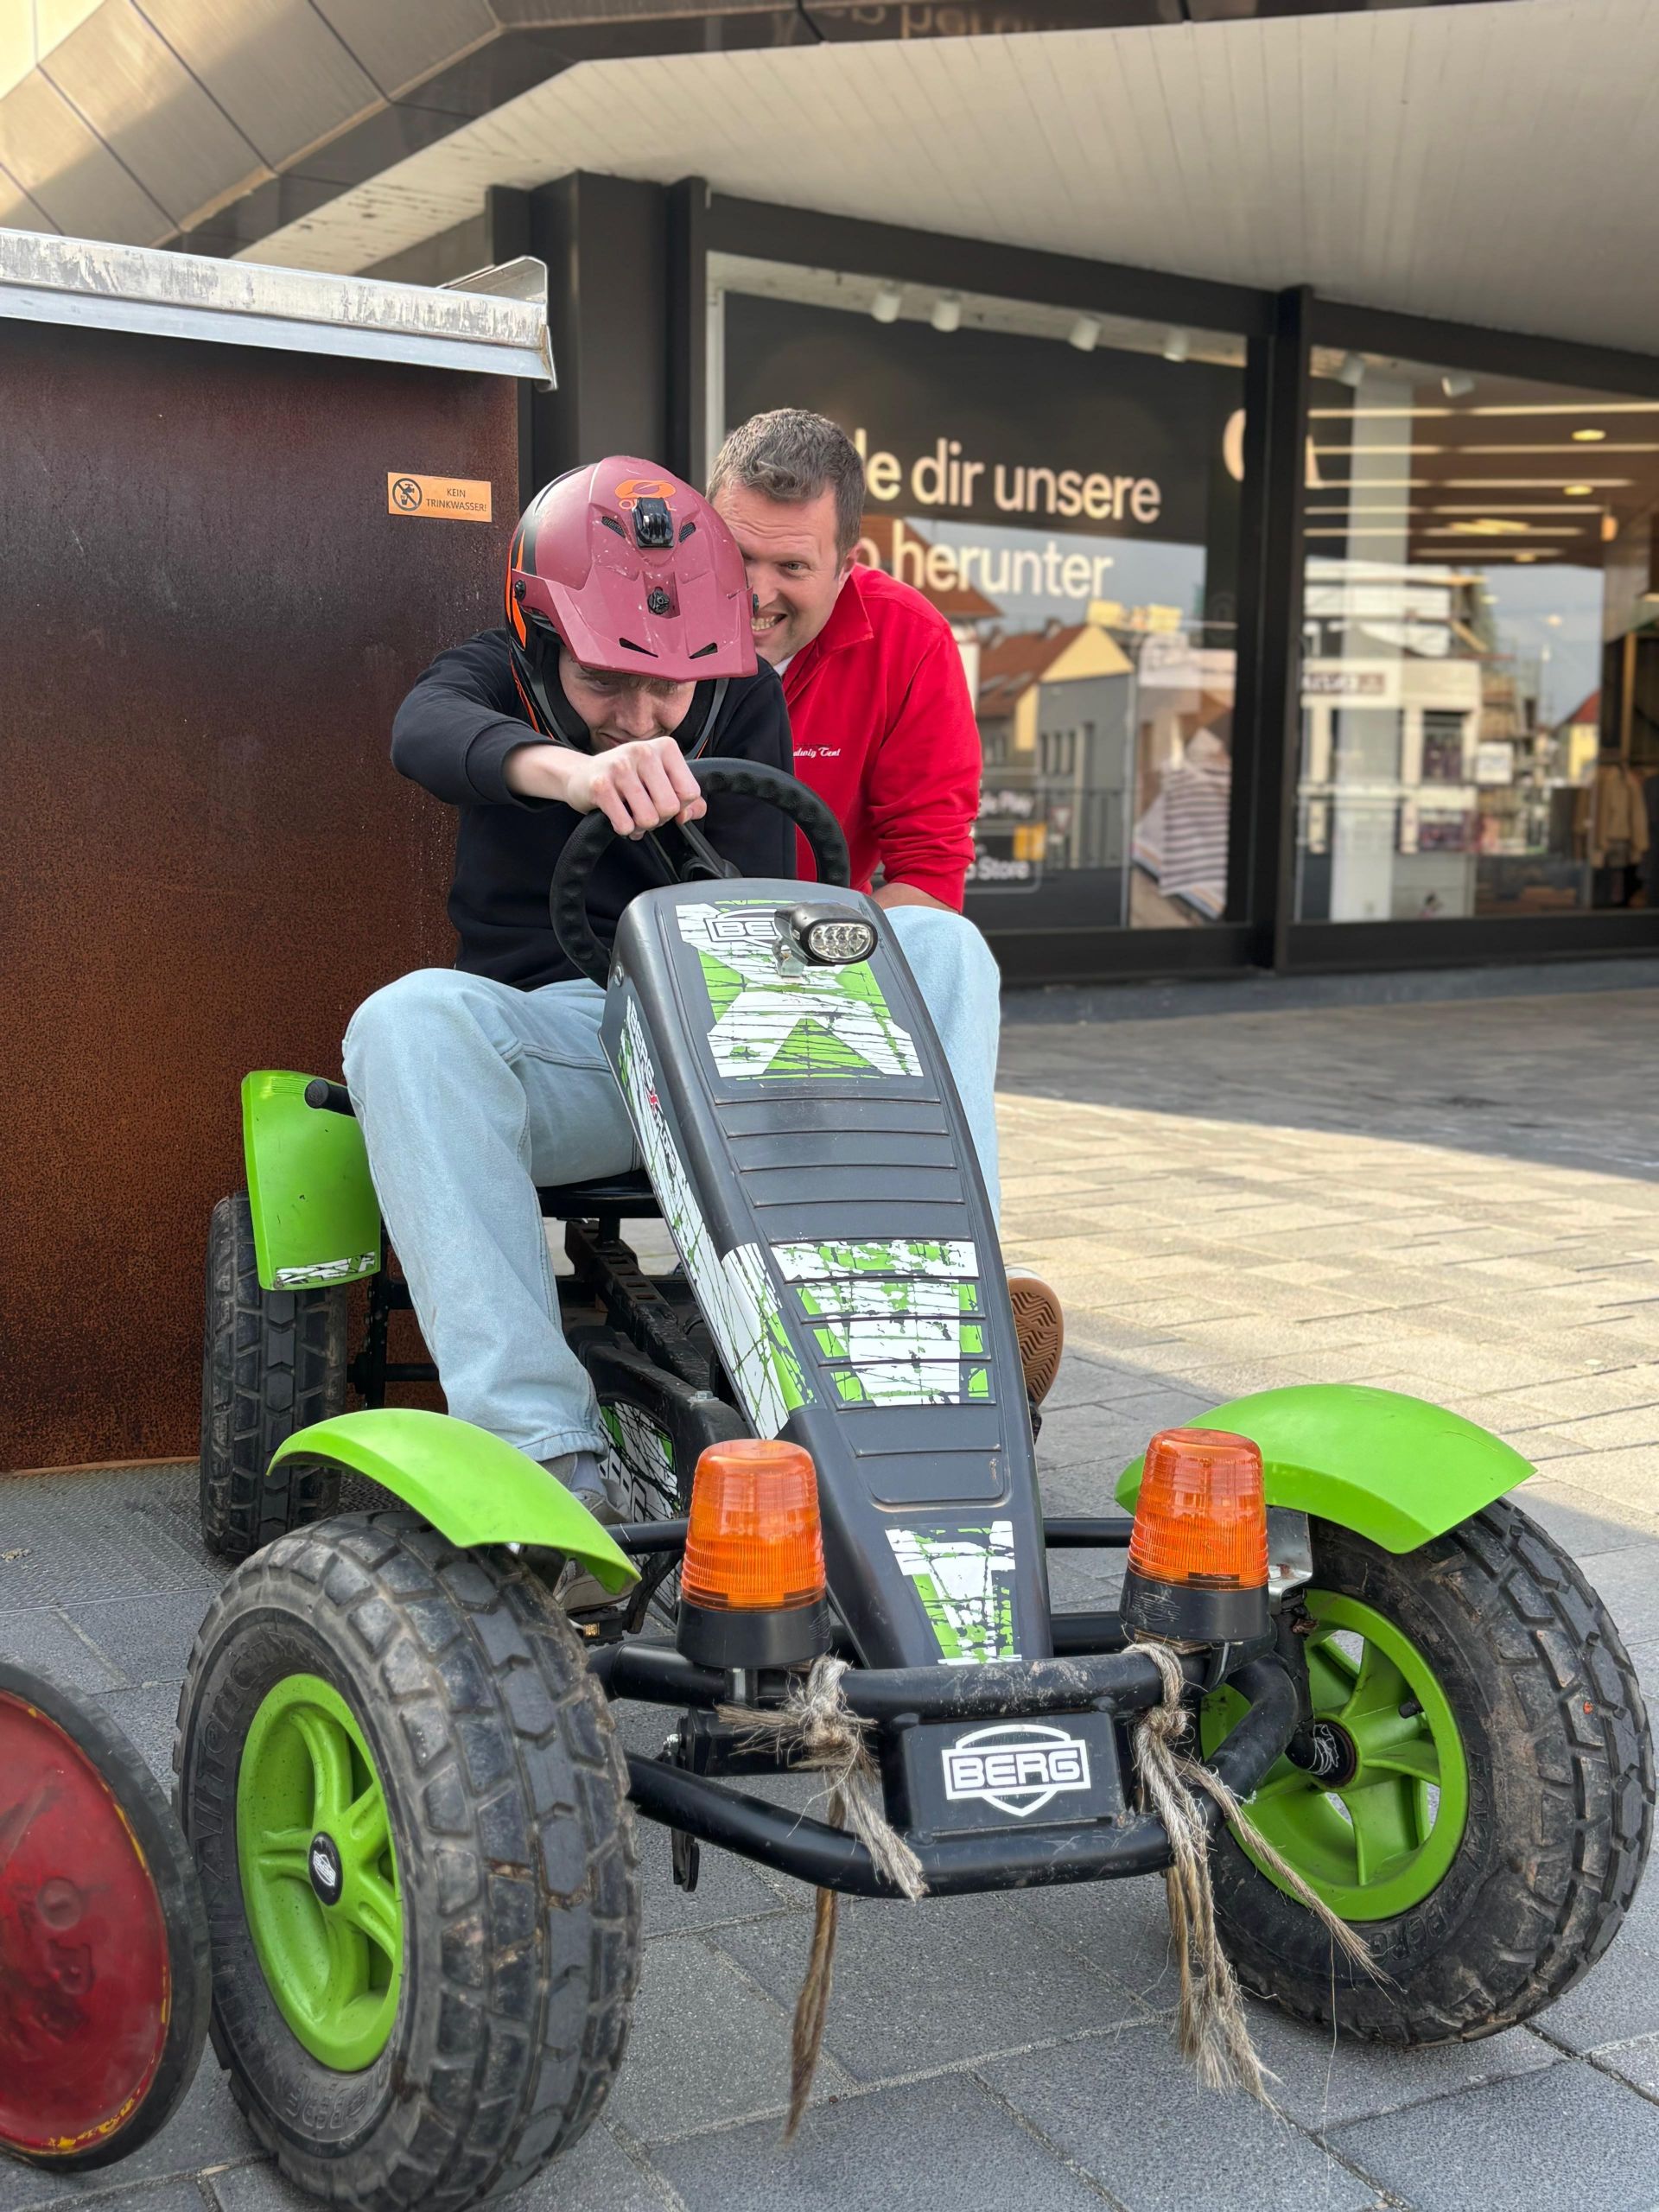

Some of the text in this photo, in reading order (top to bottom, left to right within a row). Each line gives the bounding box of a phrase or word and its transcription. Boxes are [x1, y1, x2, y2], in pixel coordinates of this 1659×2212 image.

[912, 437, 984, 505] dir
[994, 464, 1161, 524] unsere
[447, 488, 466, 498] KEIN
[426, 499, 486, 512] TRINKWASSER!
[893, 519, 1113, 598] herunter
[793, 748, 817, 758] udwig
[715, 921, 782, 937] BE
[951, 1750, 1082, 1789] BERG
